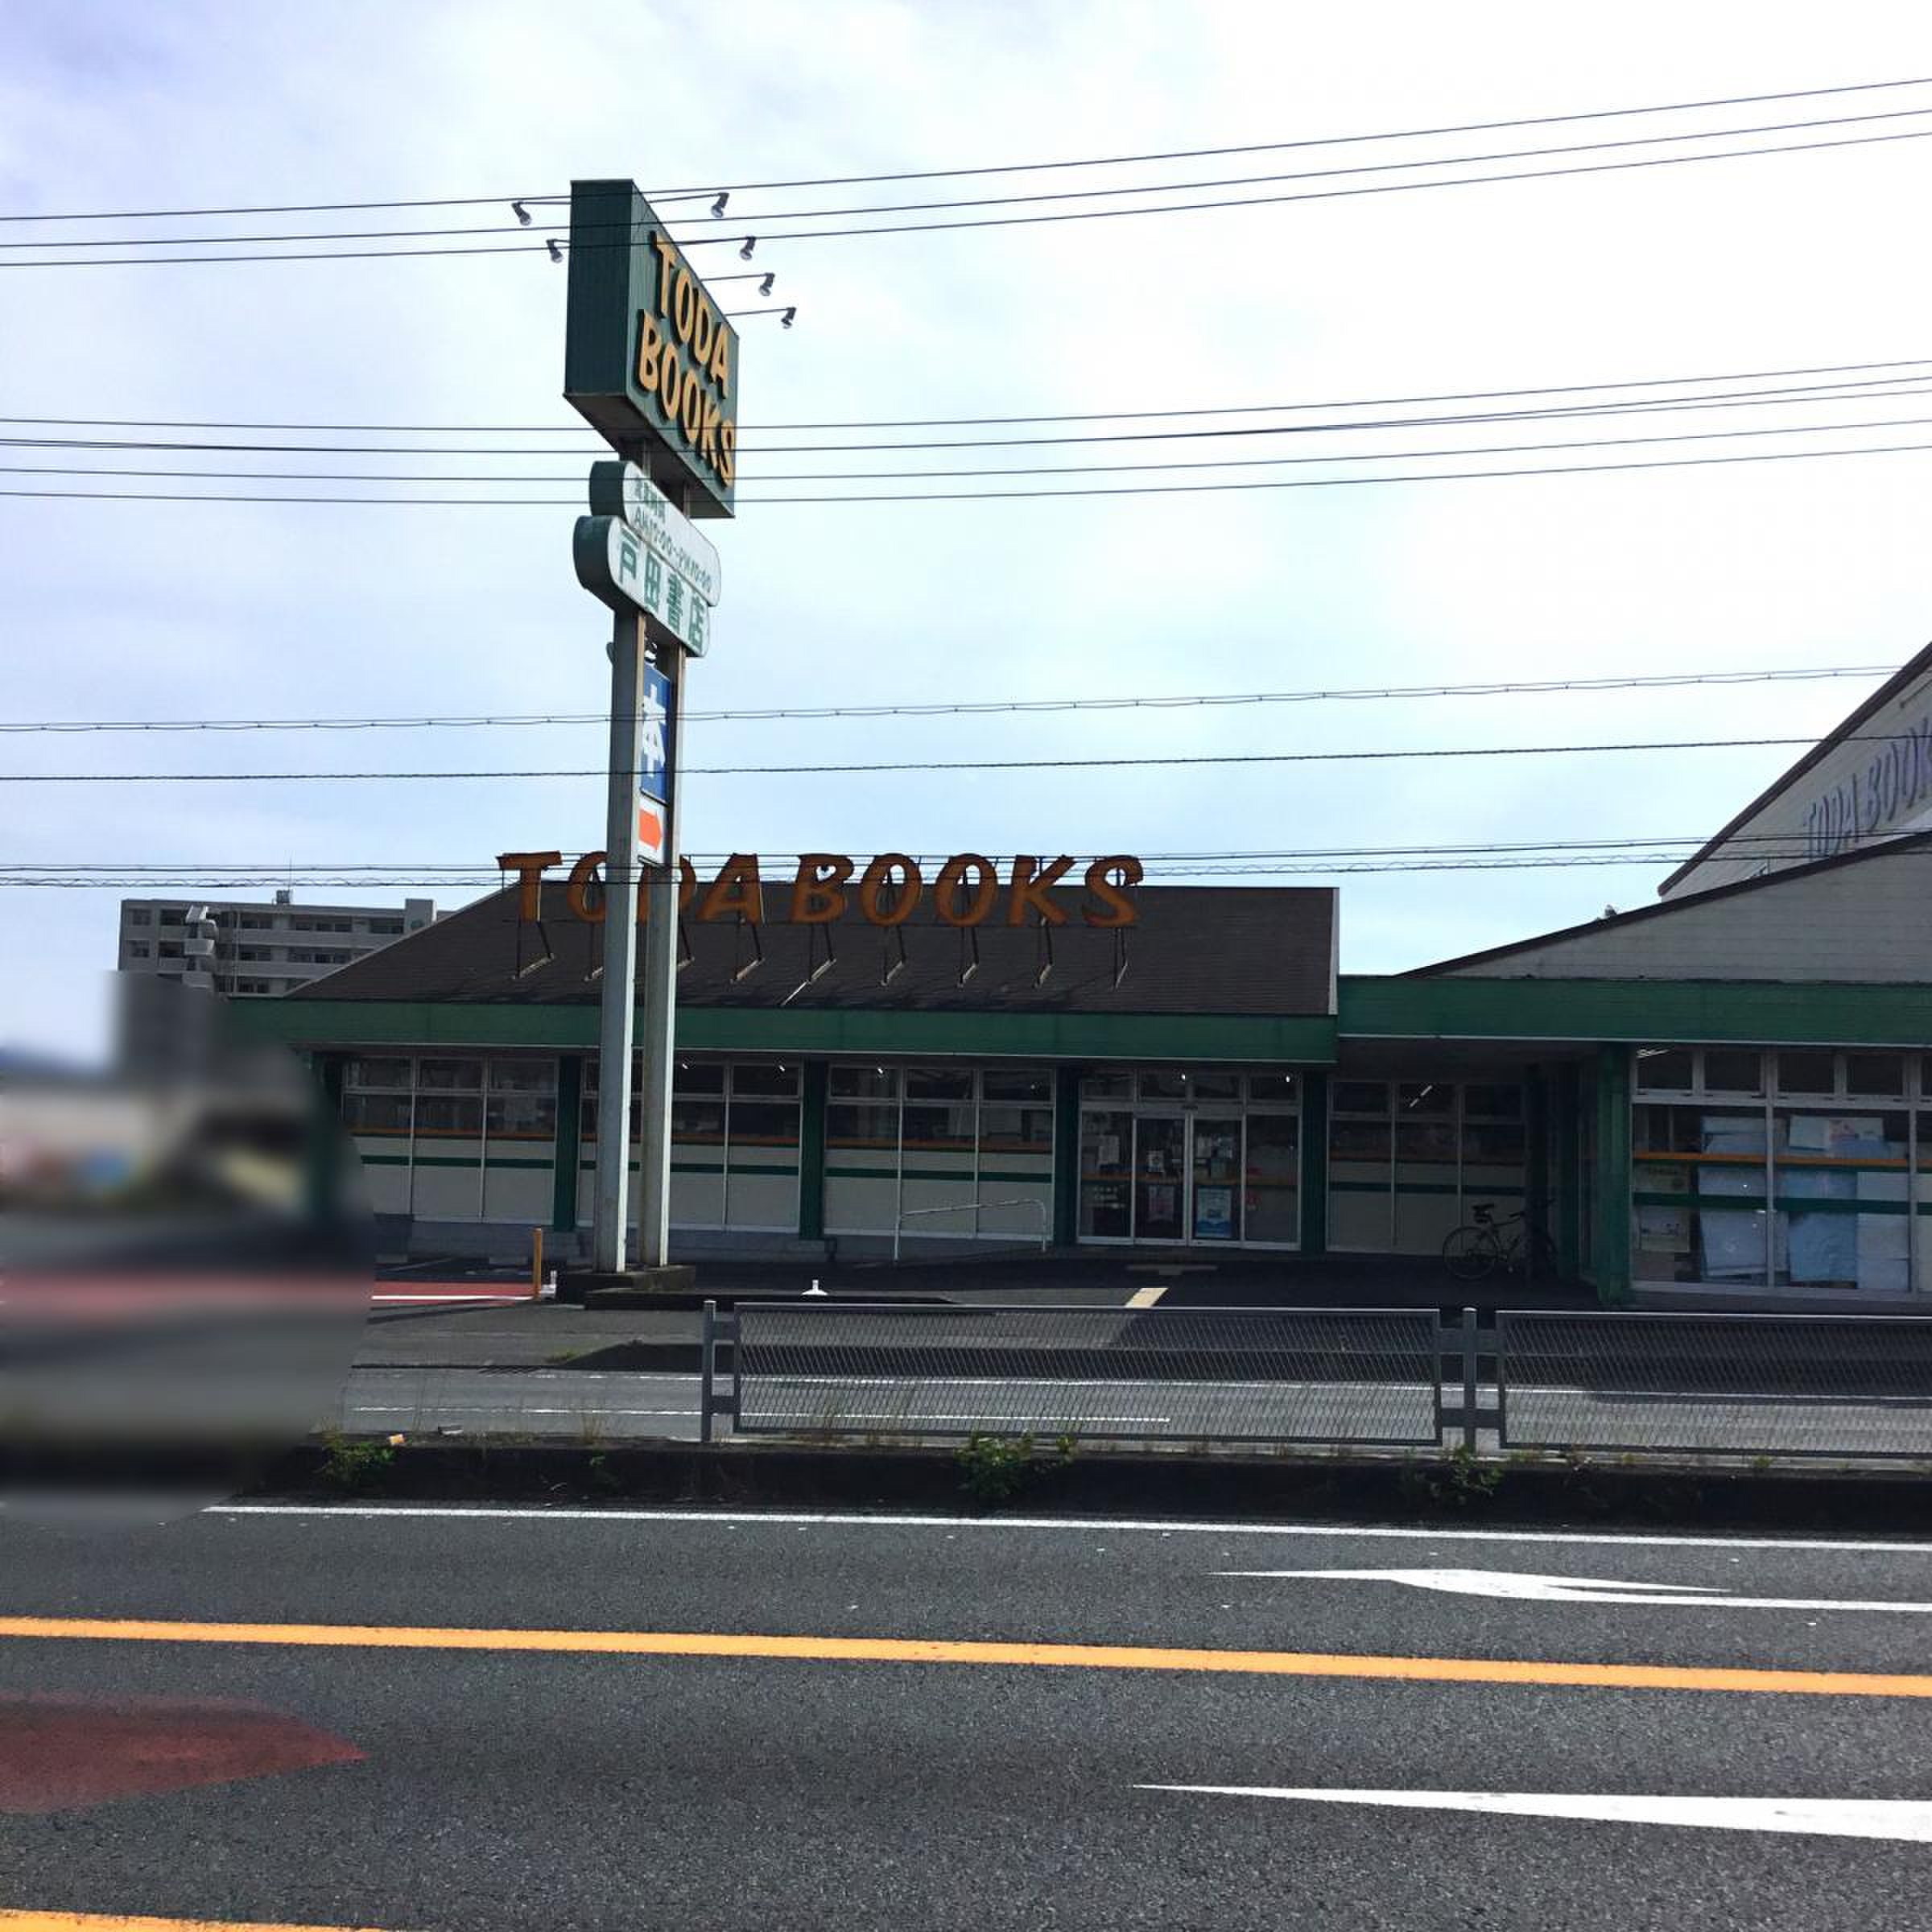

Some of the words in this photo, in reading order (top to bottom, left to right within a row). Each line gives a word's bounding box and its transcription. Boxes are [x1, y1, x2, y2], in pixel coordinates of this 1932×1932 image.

[651, 232, 729, 400] TODA
[637, 310, 737, 488] BOOKS
[618, 526, 704, 654] 戸田書店
[788, 852, 1144, 928] BOOKS
